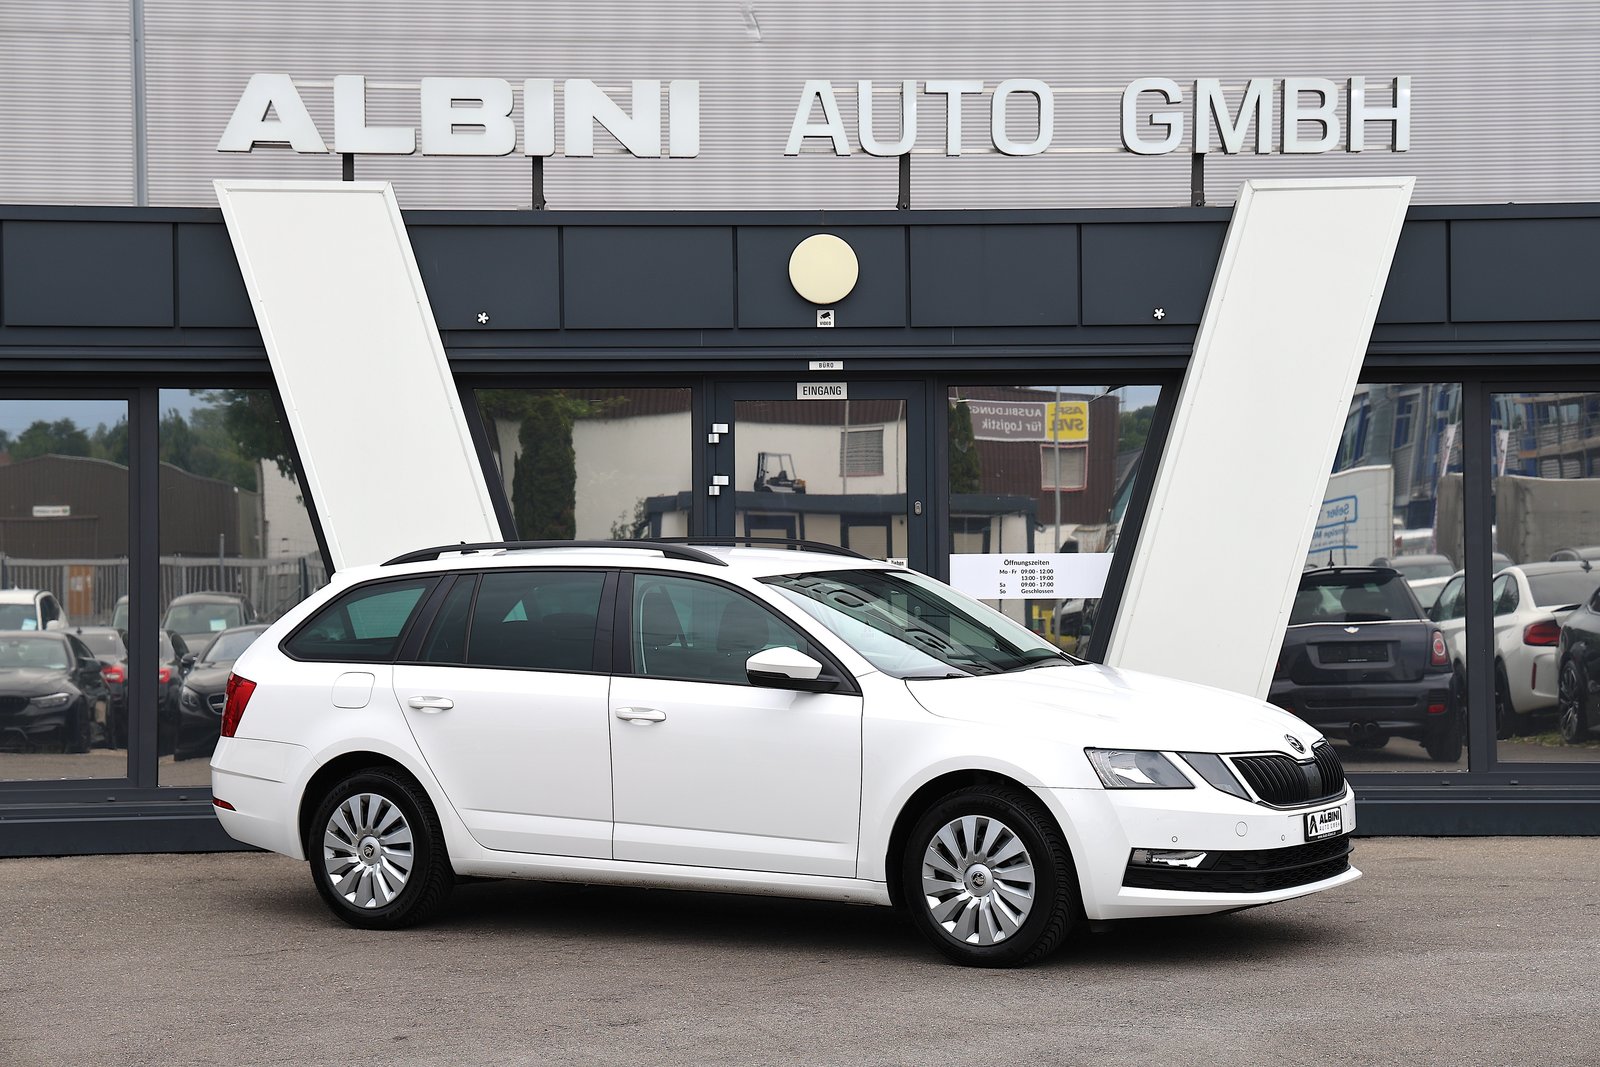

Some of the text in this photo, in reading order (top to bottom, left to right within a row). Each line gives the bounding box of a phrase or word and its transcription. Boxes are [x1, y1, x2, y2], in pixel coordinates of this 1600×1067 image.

[216, 73, 1412, 158] ALBINI AUTO GMBH
[802, 386, 842, 396] EINGANG
[1319, 810, 1340, 824] ALBINI
